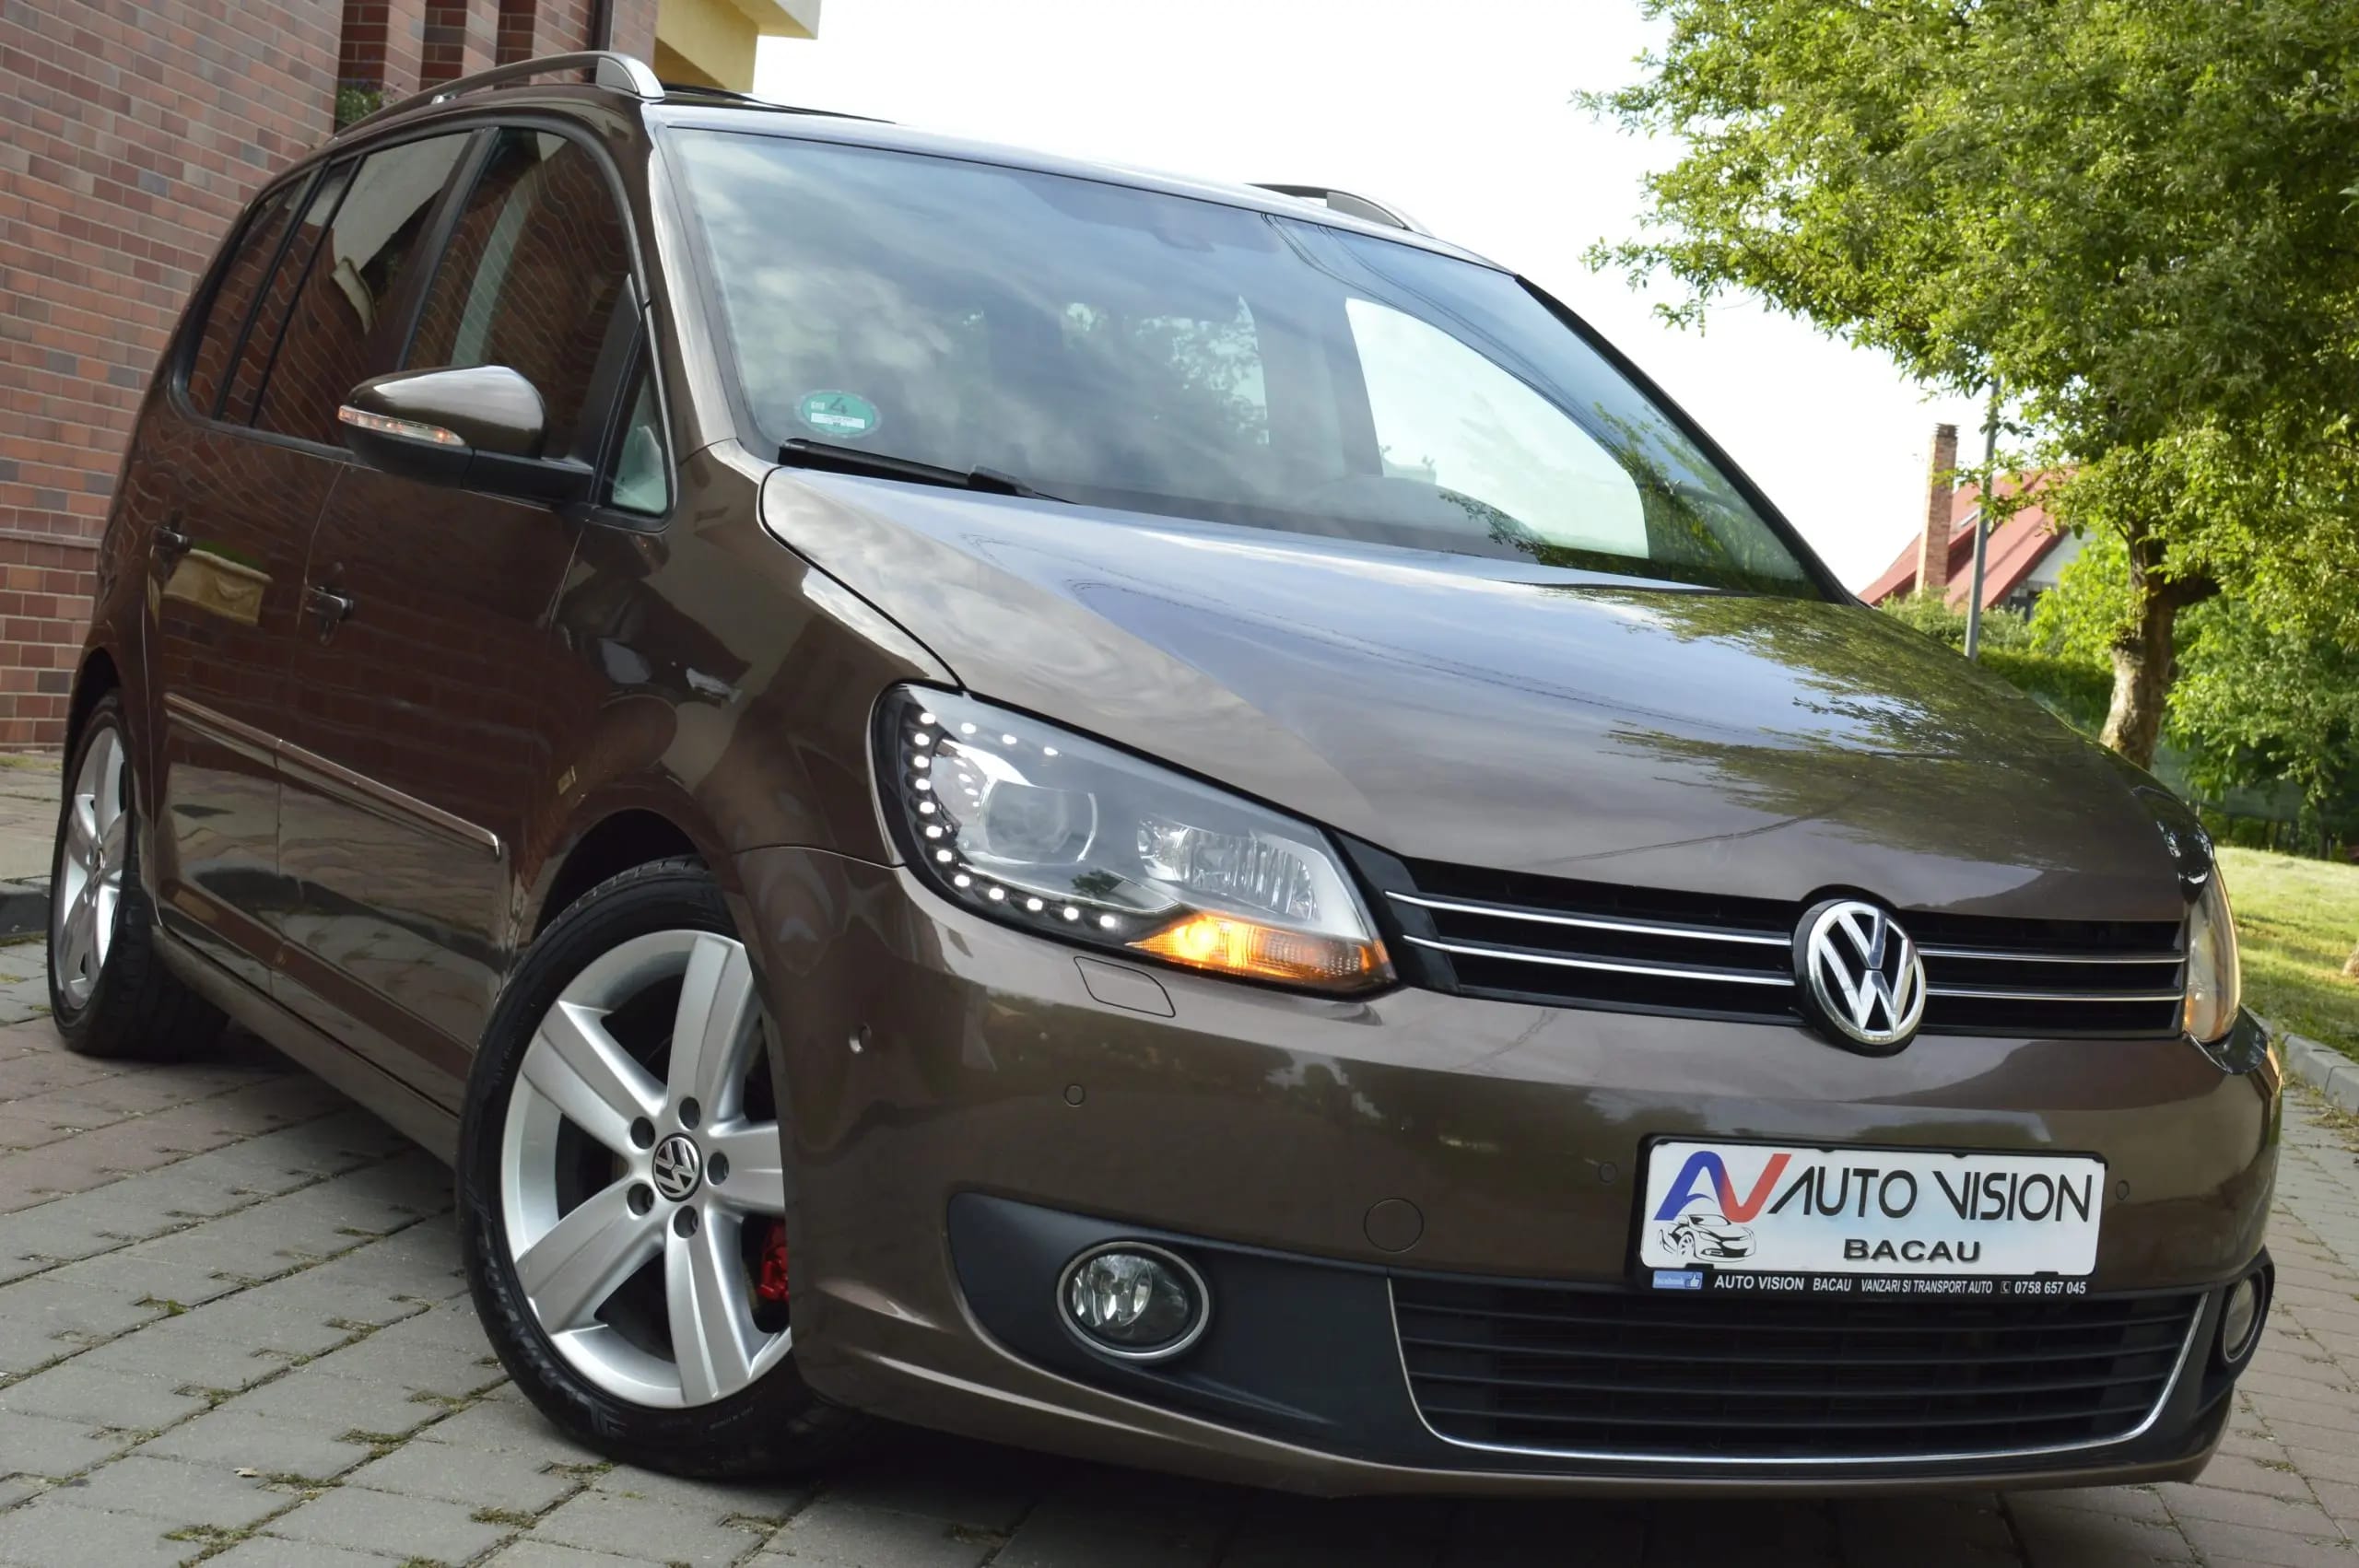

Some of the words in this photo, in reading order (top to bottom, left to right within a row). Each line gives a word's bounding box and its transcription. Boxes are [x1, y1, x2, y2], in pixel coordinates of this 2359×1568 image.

[1809, 901, 1926, 1043] VW
[654, 1136, 700, 1198] VW
[1766, 1165, 1918, 1219] AUTO
[1931, 1171, 2093, 1223] VISION
[1843, 1238, 1980, 1262] BACAU
[1714, 1275, 1755, 1290] AUTO
[1758, 1276, 1805, 1291] VISION
[1813, 1278, 1852, 1292] BACAU
[1860, 1279, 1901, 1293] VANZARI
[1902, 1280, 1912, 1293] SI
[1913, 1280, 1968, 1293] TRANSPORT
[1967, 1281, 1993, 1293] AUTO
[2014, 1281, 2041, 1294] 0758
[2044, 1281, 2065, 1294] 657
[2066, 1281, 2087, 1294] 045
